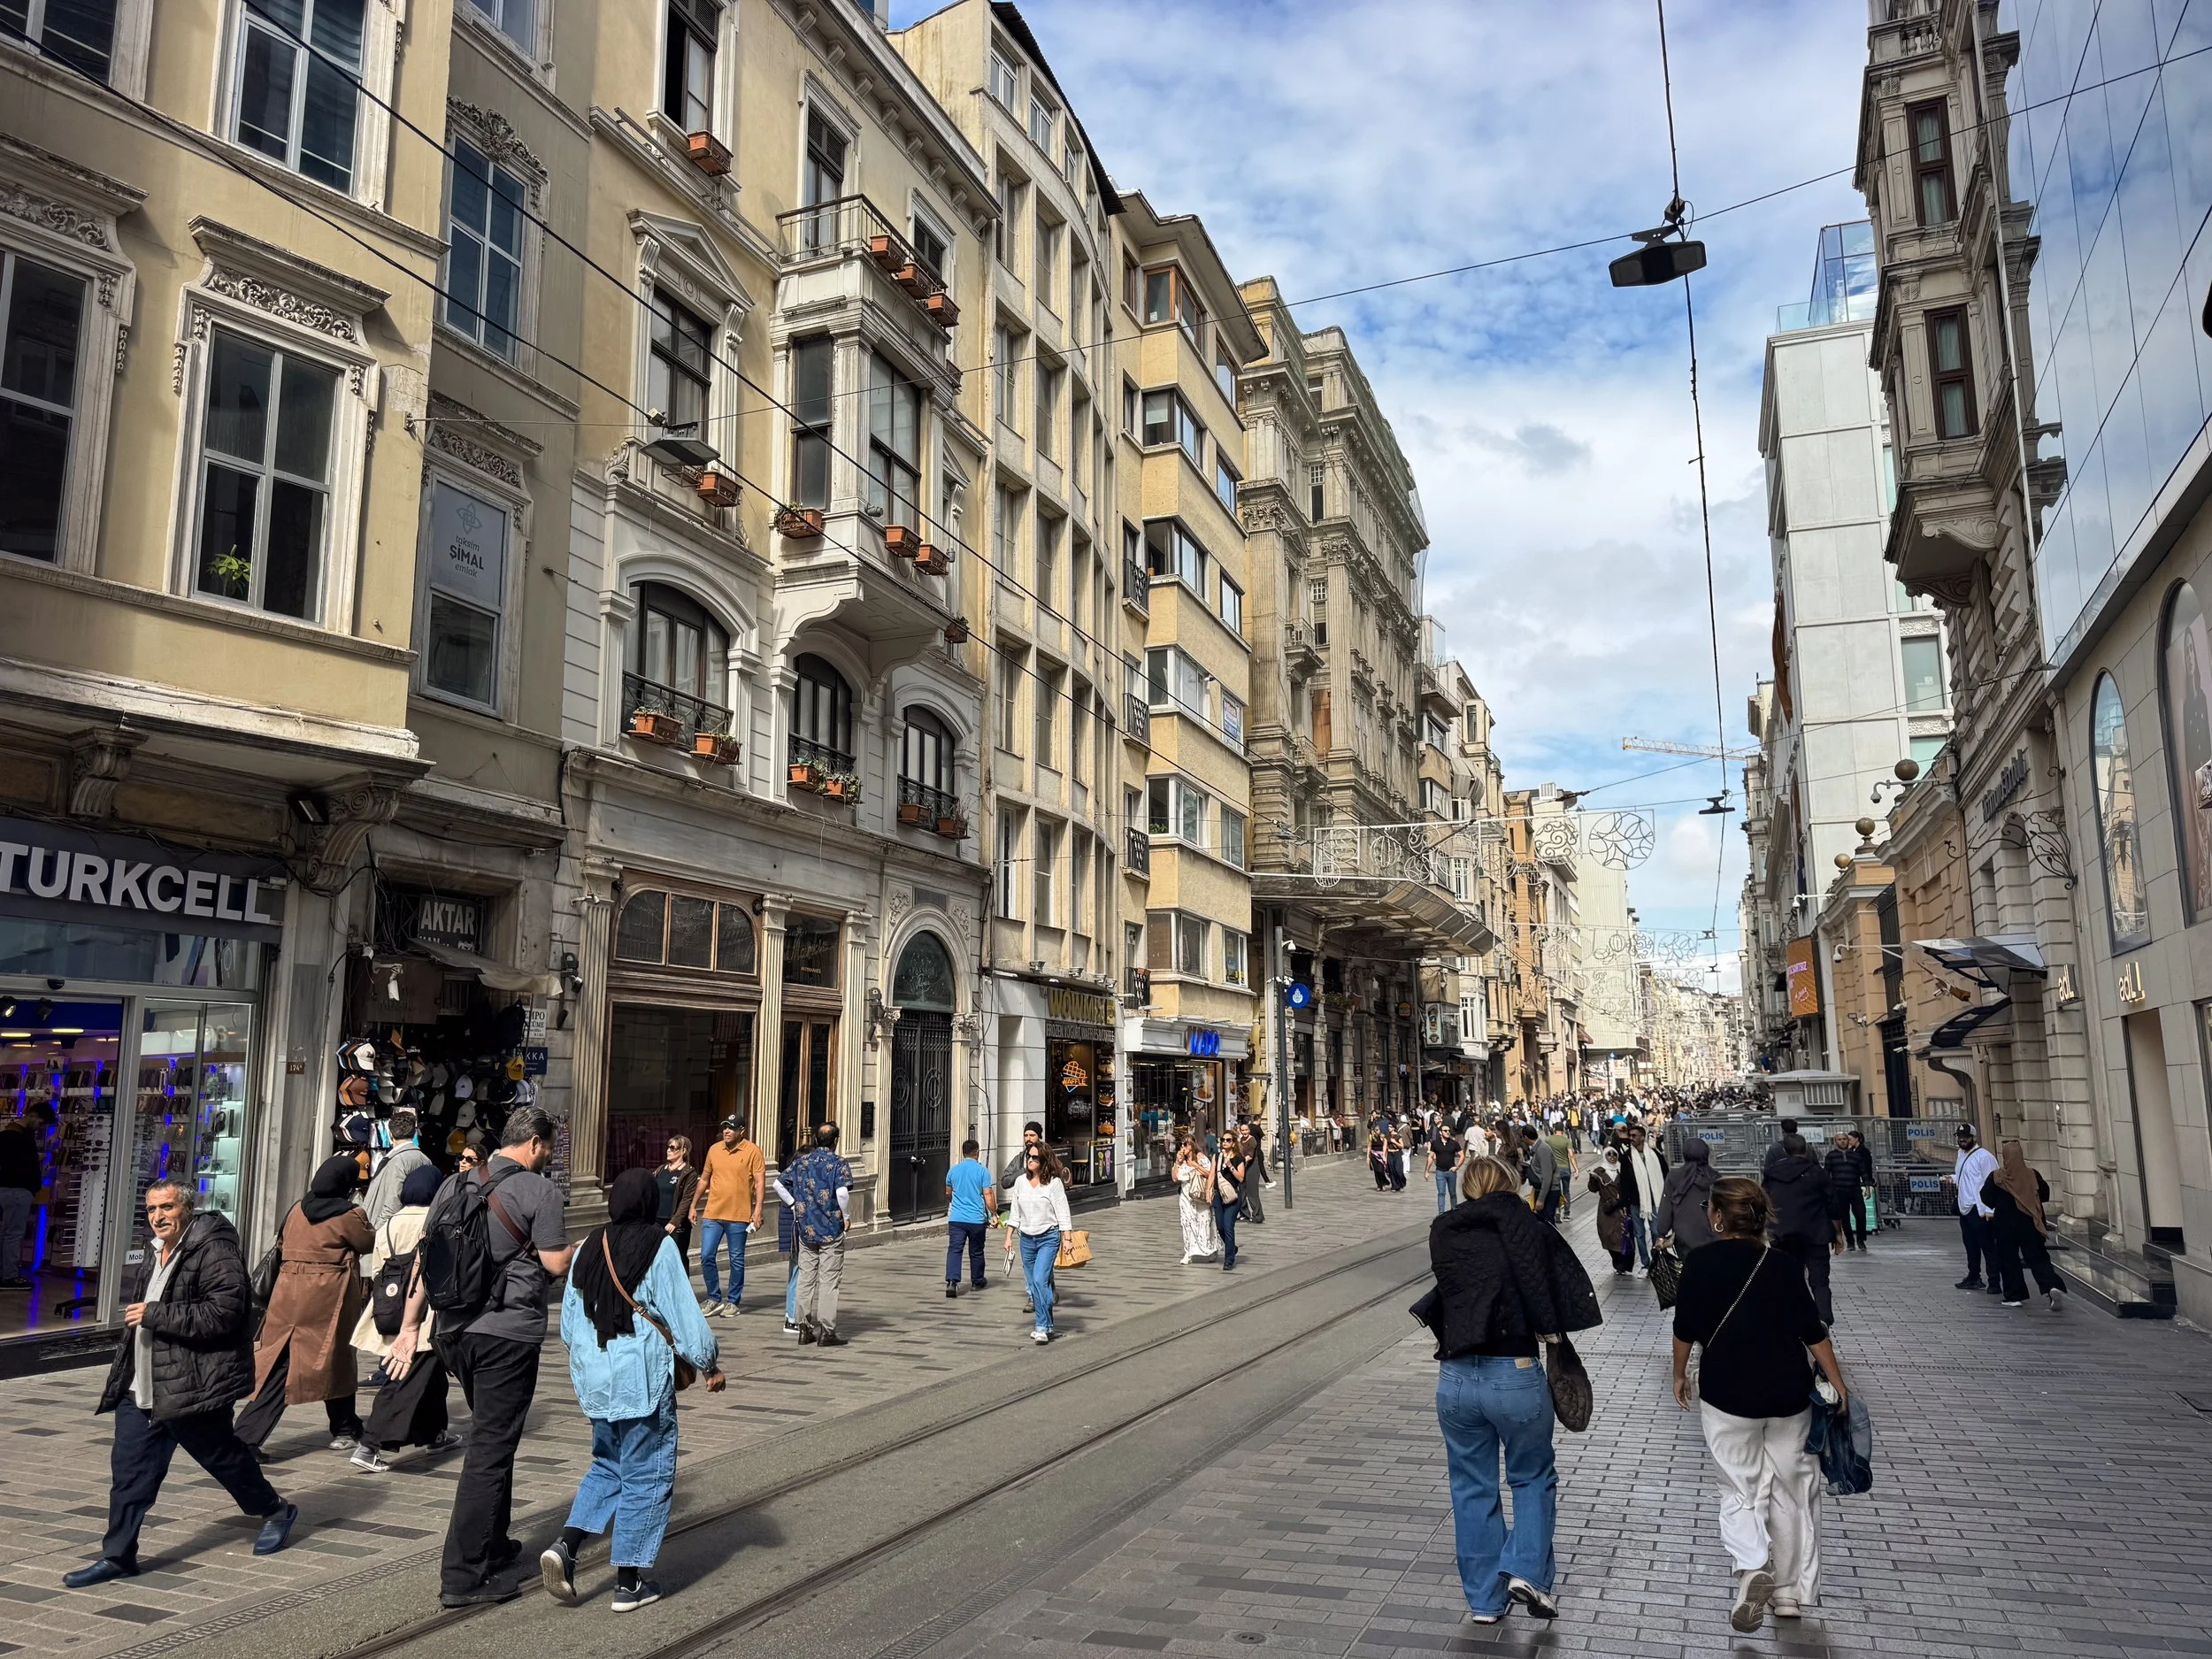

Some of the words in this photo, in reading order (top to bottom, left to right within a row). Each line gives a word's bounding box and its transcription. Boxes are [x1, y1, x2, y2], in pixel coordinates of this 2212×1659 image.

[456, 535, 480, 551] taksim
[455, 564, 478, 578] emlak
[0, 841, 271, 924] TURKCELL
[420, 901, 475, 935] AKTAR
[1699, 1132, 1724, 1141] POLİS
[1908, 1126, 1936, 1137] POLİS
[1910, 1179, 1939, 1188] POLİS
